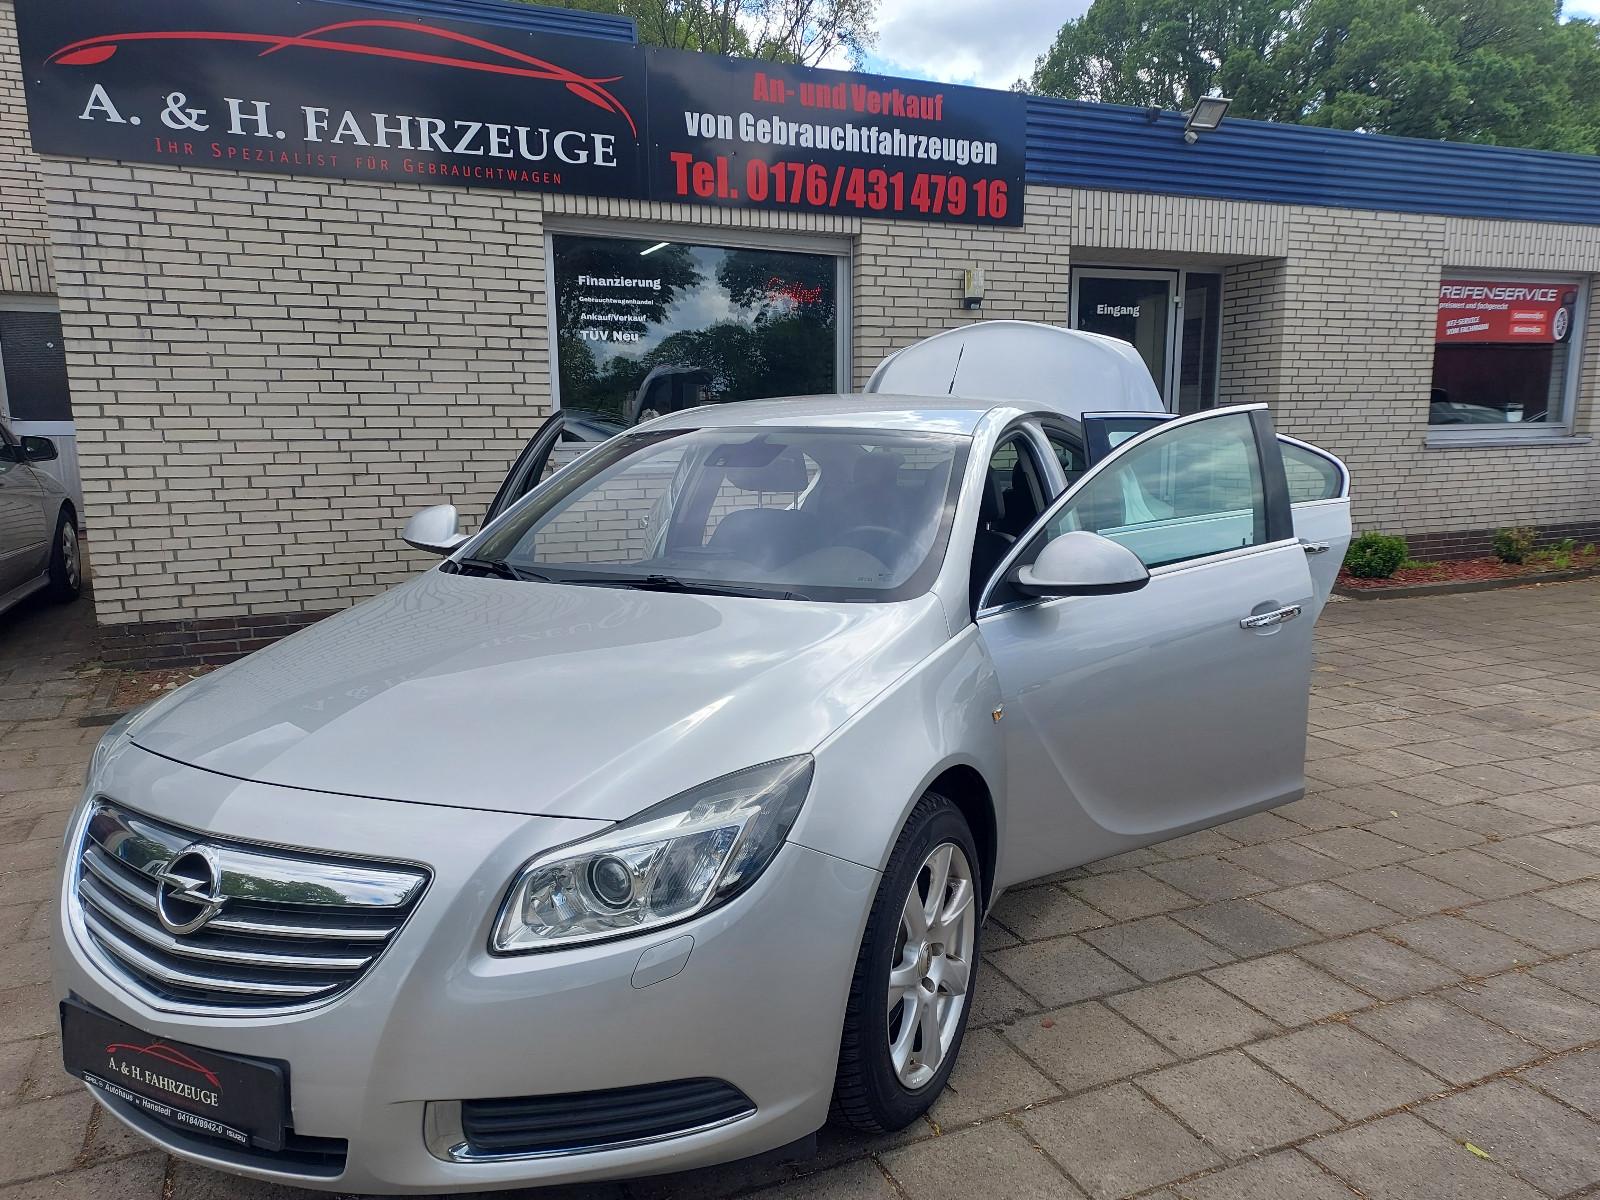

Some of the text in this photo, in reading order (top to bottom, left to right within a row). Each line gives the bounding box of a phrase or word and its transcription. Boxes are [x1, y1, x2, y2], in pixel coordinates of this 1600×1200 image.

[753, 72, 944, 121] An- und Verkauf
[78, 83, 617, 167] A. & H. FAHRZEUGE
[685, 111, 998, 166] von Gebrauchtfahrzeugen
[670, 151, 738, 199] Tel.
[973, 178, 1008, 219] 16
[578, 275, 661, 290] Finanzierung
[1440, 285, 1558, 302] REIFENSERVICE
[580, 312, 647, 322] Ankauf/Verkauf
[1096, 303, 1141, 318] Eingang
[580, 328, 639, 341] TÜV Neu
[108, 1056, 119, 1071] A.
[121, 1061, 130, 1075] &
[132, 1065, 144, 1082] H.
[145, 1072, 219, 1107] FAHRZEUGE
[104, 1084, 134, 1102] Autohaus
[142, 1099, 171, 1117] Hanstedt
